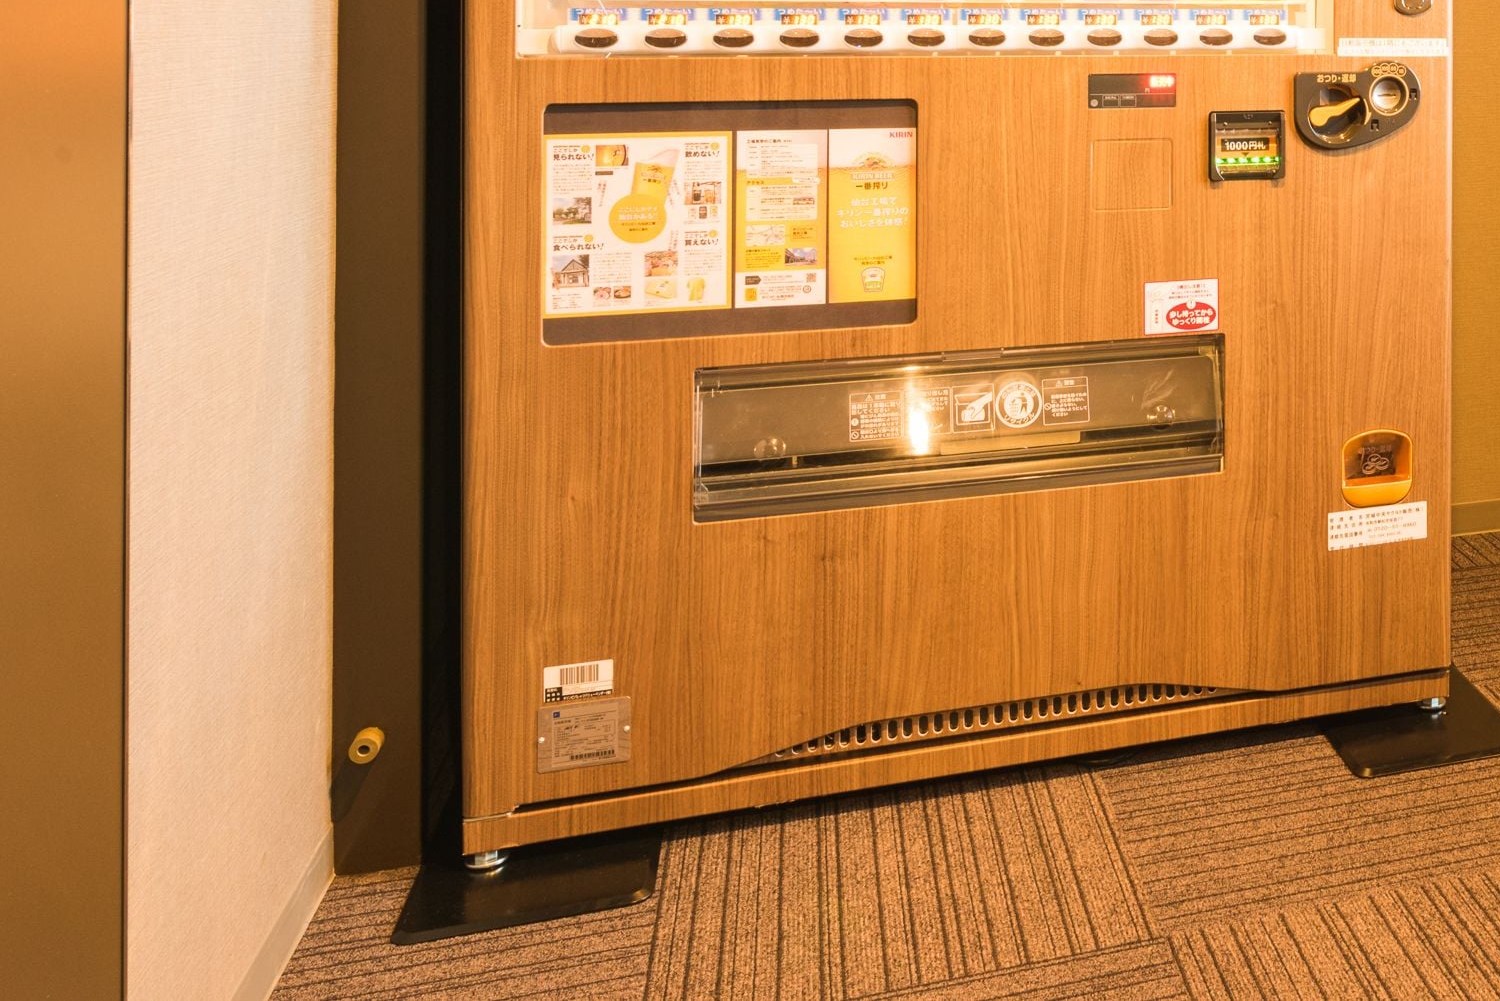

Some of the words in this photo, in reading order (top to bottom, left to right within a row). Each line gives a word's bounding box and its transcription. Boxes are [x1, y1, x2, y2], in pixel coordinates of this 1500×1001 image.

[1317, 74, 1356, 83] おつり・返却
[1224, 140, 1266, 150] 1000円札
[553, 153, 594, 161] 見られない!
[685, 150, 720, 158] 飲めない!
[856, 182, 888, 190] 一番搾り
[837, 207, 909, 217] キリン一番搾りの
[685, 238, 719, 246] 買えない!
[553, 243, 604, 251] 食べられない!
[1002, 412, 1035, 426] リサイクル
